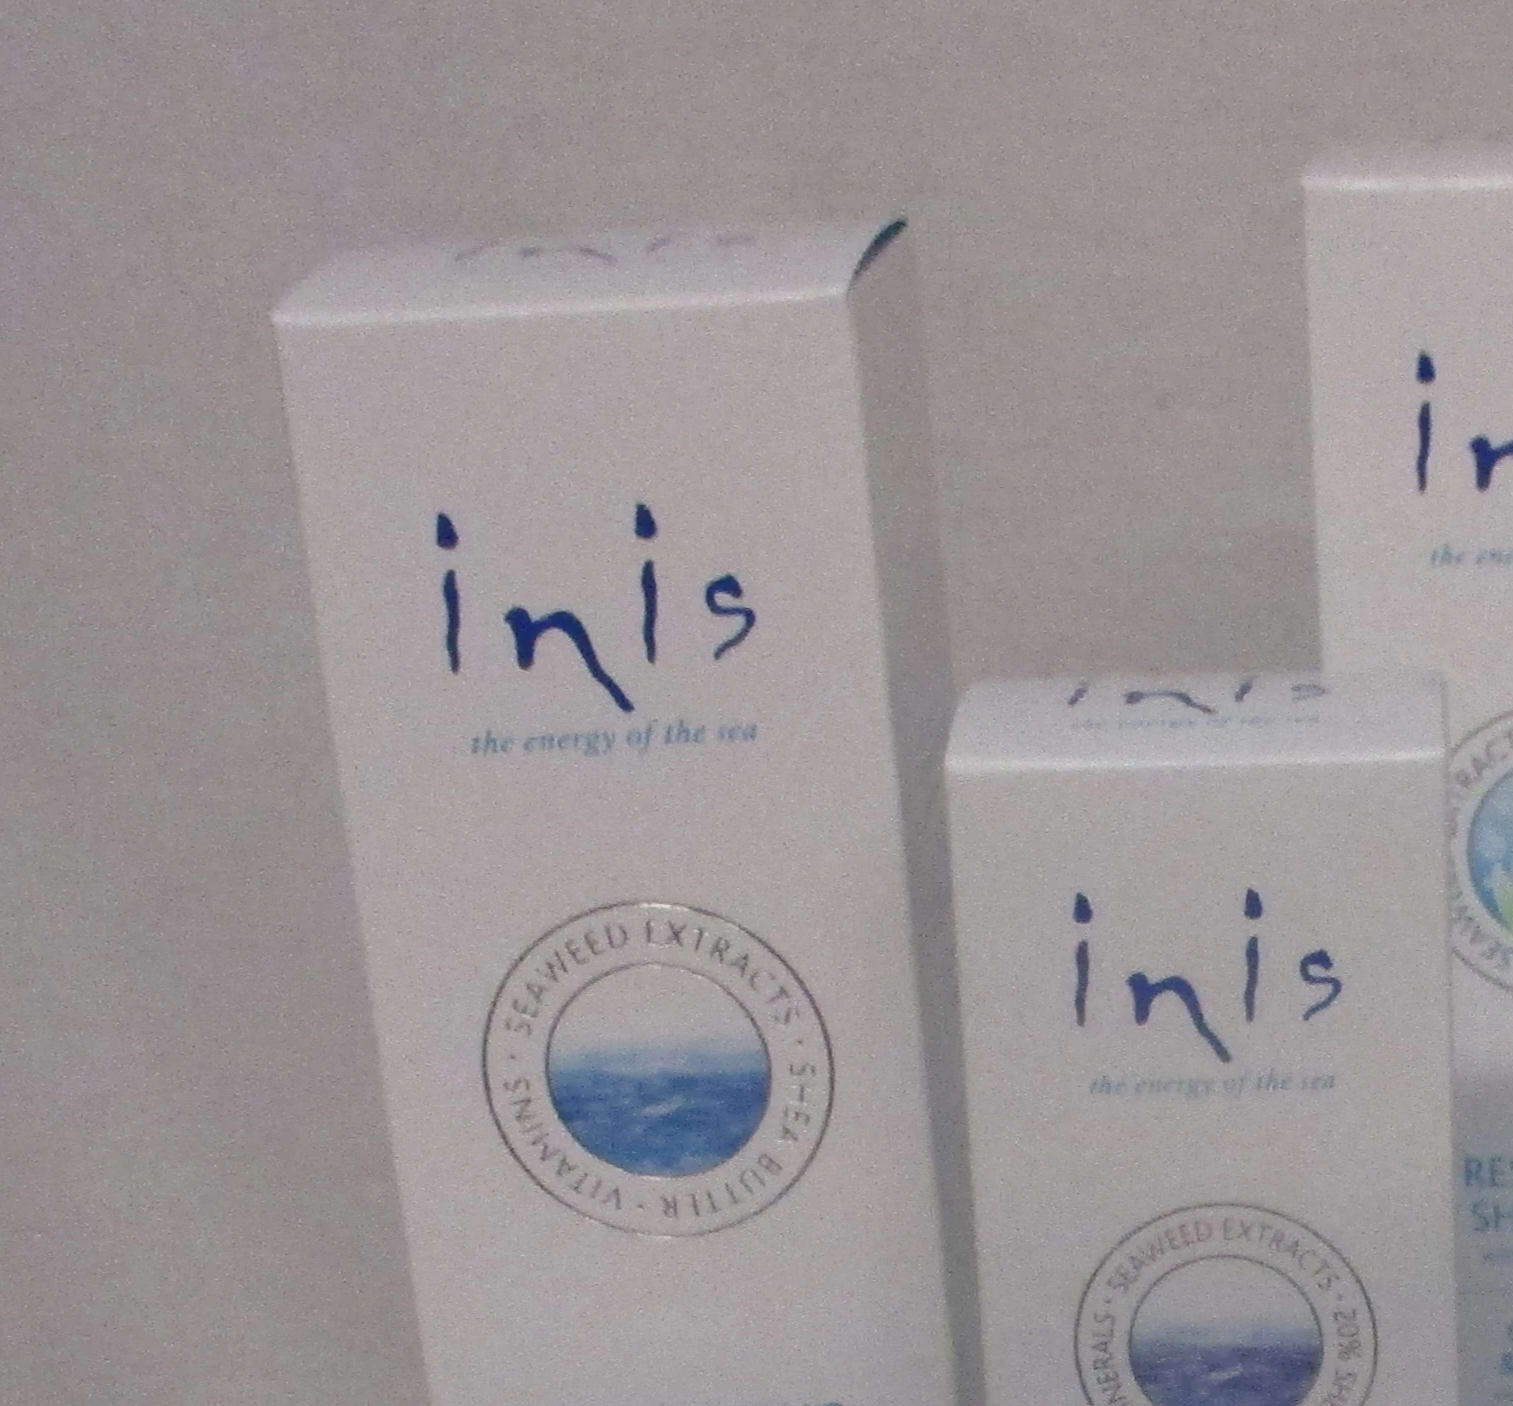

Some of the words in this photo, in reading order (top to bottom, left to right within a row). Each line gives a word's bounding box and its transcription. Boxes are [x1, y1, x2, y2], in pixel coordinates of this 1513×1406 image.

[436, 503, 756, 713] inis
[471, 729, 512, 755] the
[523, 730, 616, 757] energy
[627, 719, 659, 755] of
[665, 719, 705, 745] the
[717, 723, 757, 742] sea
[505, 921, 629, 1037] SEAWEED
[645, 919, 799, 1026] EXTRACTS
[1073, 888, 1342, 1064] inis
[1090, 1074, 1125, 1096] the
[1134, 1078, 1215, 1098] energy
[1223, 1074, 1248, 1098] of
[1256, 1069, 1290, 1091] the
[1301, 1073, 1337, 1091] sea
[502, 1076, 624, 1211] VITAMINS
[660, 1151, 784, 1220] BUTTER
[1106, 1219, 1214, 1297] SEAWEED
[1222, 1216, 1341, 1293] EXTRACTS
